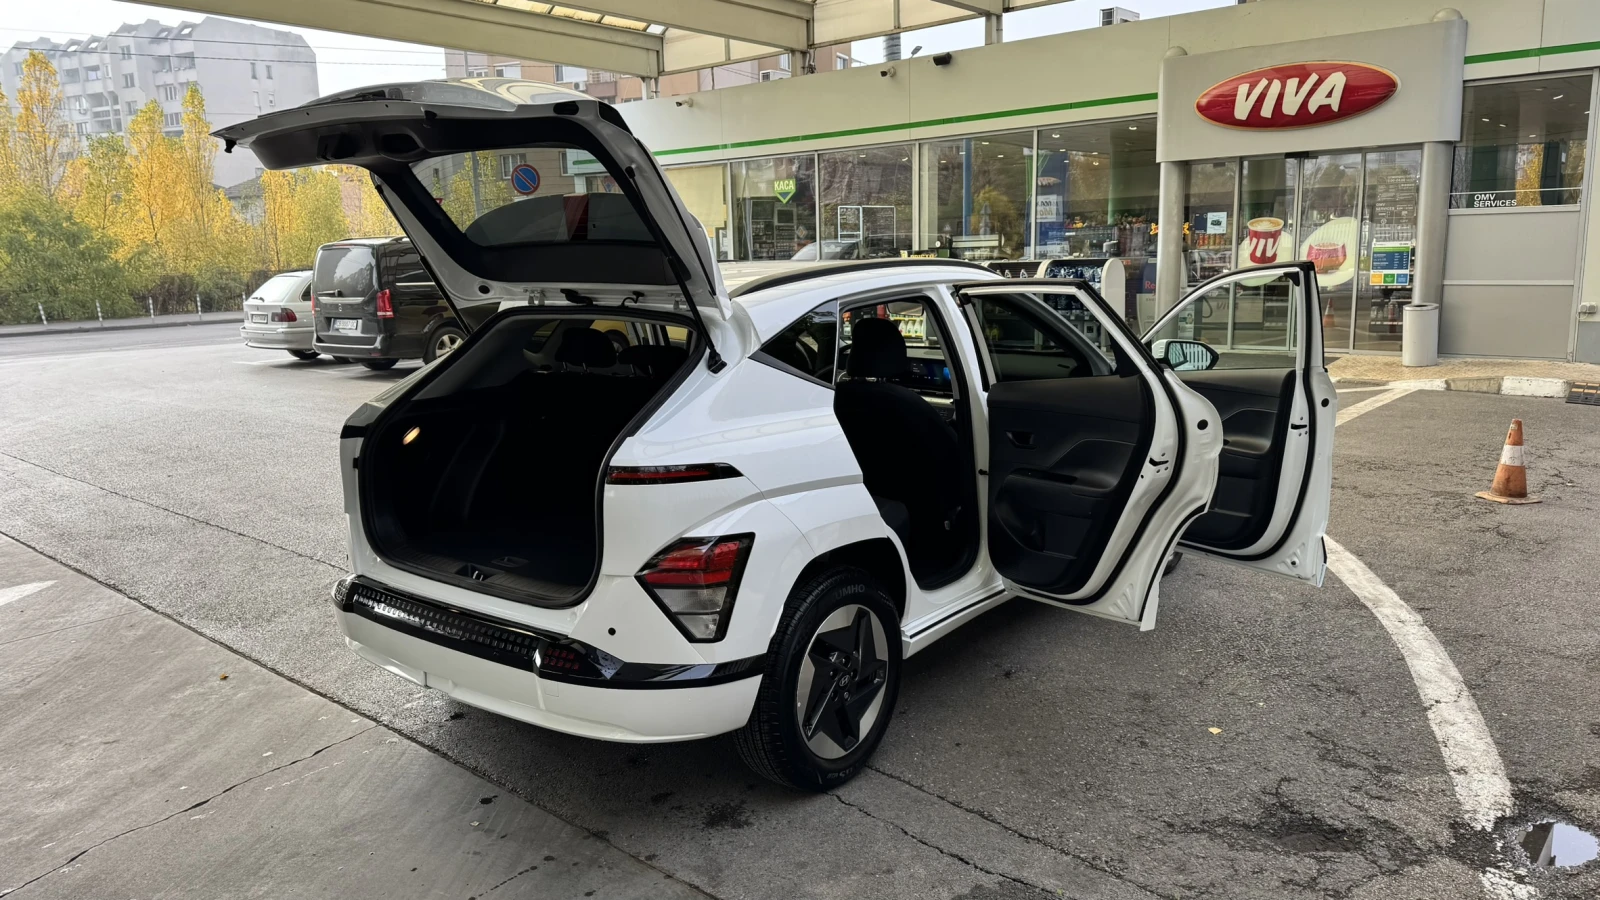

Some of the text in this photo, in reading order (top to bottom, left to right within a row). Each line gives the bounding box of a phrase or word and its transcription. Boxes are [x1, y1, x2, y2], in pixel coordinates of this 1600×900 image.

[1233, 71, 1347, 121] VIVA
[774, 180, 795, 191] КАСА
[1474, 193, 1496, 201] OMV
[1473, 200, 1517, 208] SERVICES
[833, 583, 865, 600] UMHO
